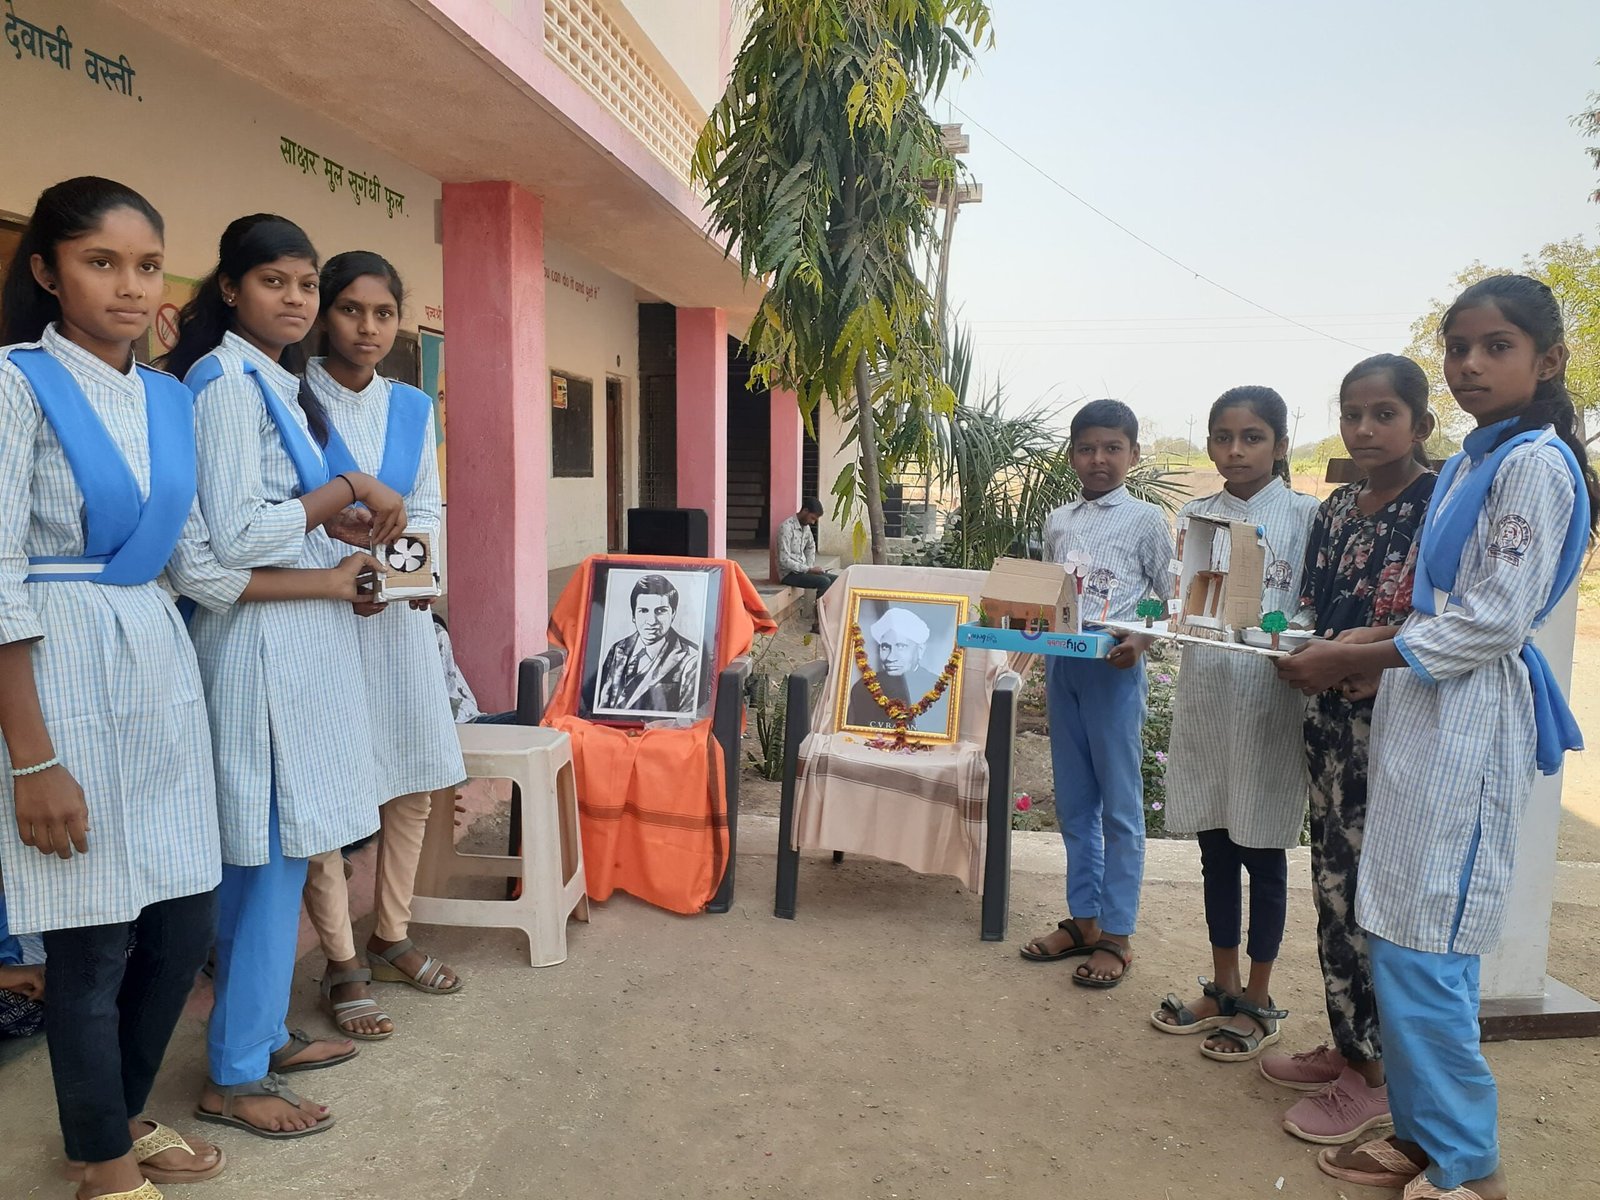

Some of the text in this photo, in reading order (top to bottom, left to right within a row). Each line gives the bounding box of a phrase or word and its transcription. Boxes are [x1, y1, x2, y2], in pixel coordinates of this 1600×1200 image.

[280, 135, 320, 175] साक्षर
[551, 269, 561, 284] can
[562, 271, 570, 288] do
[575, 280, 585, 295] and
